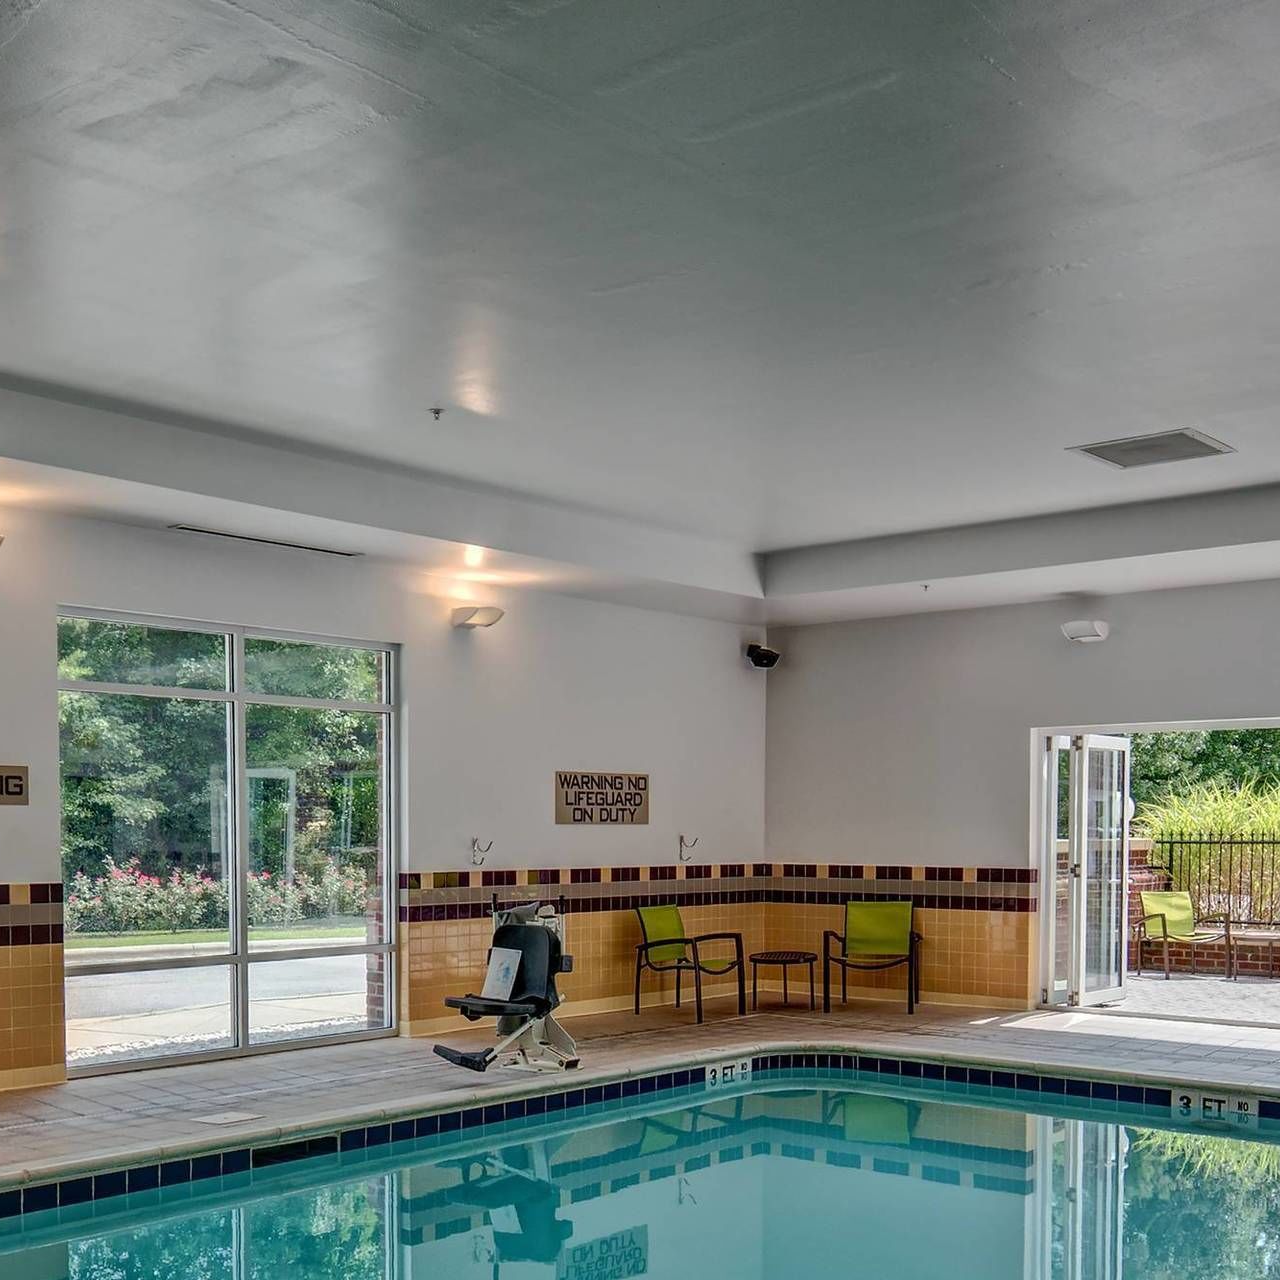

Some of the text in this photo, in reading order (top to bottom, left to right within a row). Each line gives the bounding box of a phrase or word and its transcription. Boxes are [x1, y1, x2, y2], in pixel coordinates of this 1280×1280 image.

[559, 774, 647, 791] WARNING NO
[565, 791, 643, 807] LIFEGUARD
[572, 807, 637, 822] ON DUTY
[1202, 1098, 1226, 1112] FT
